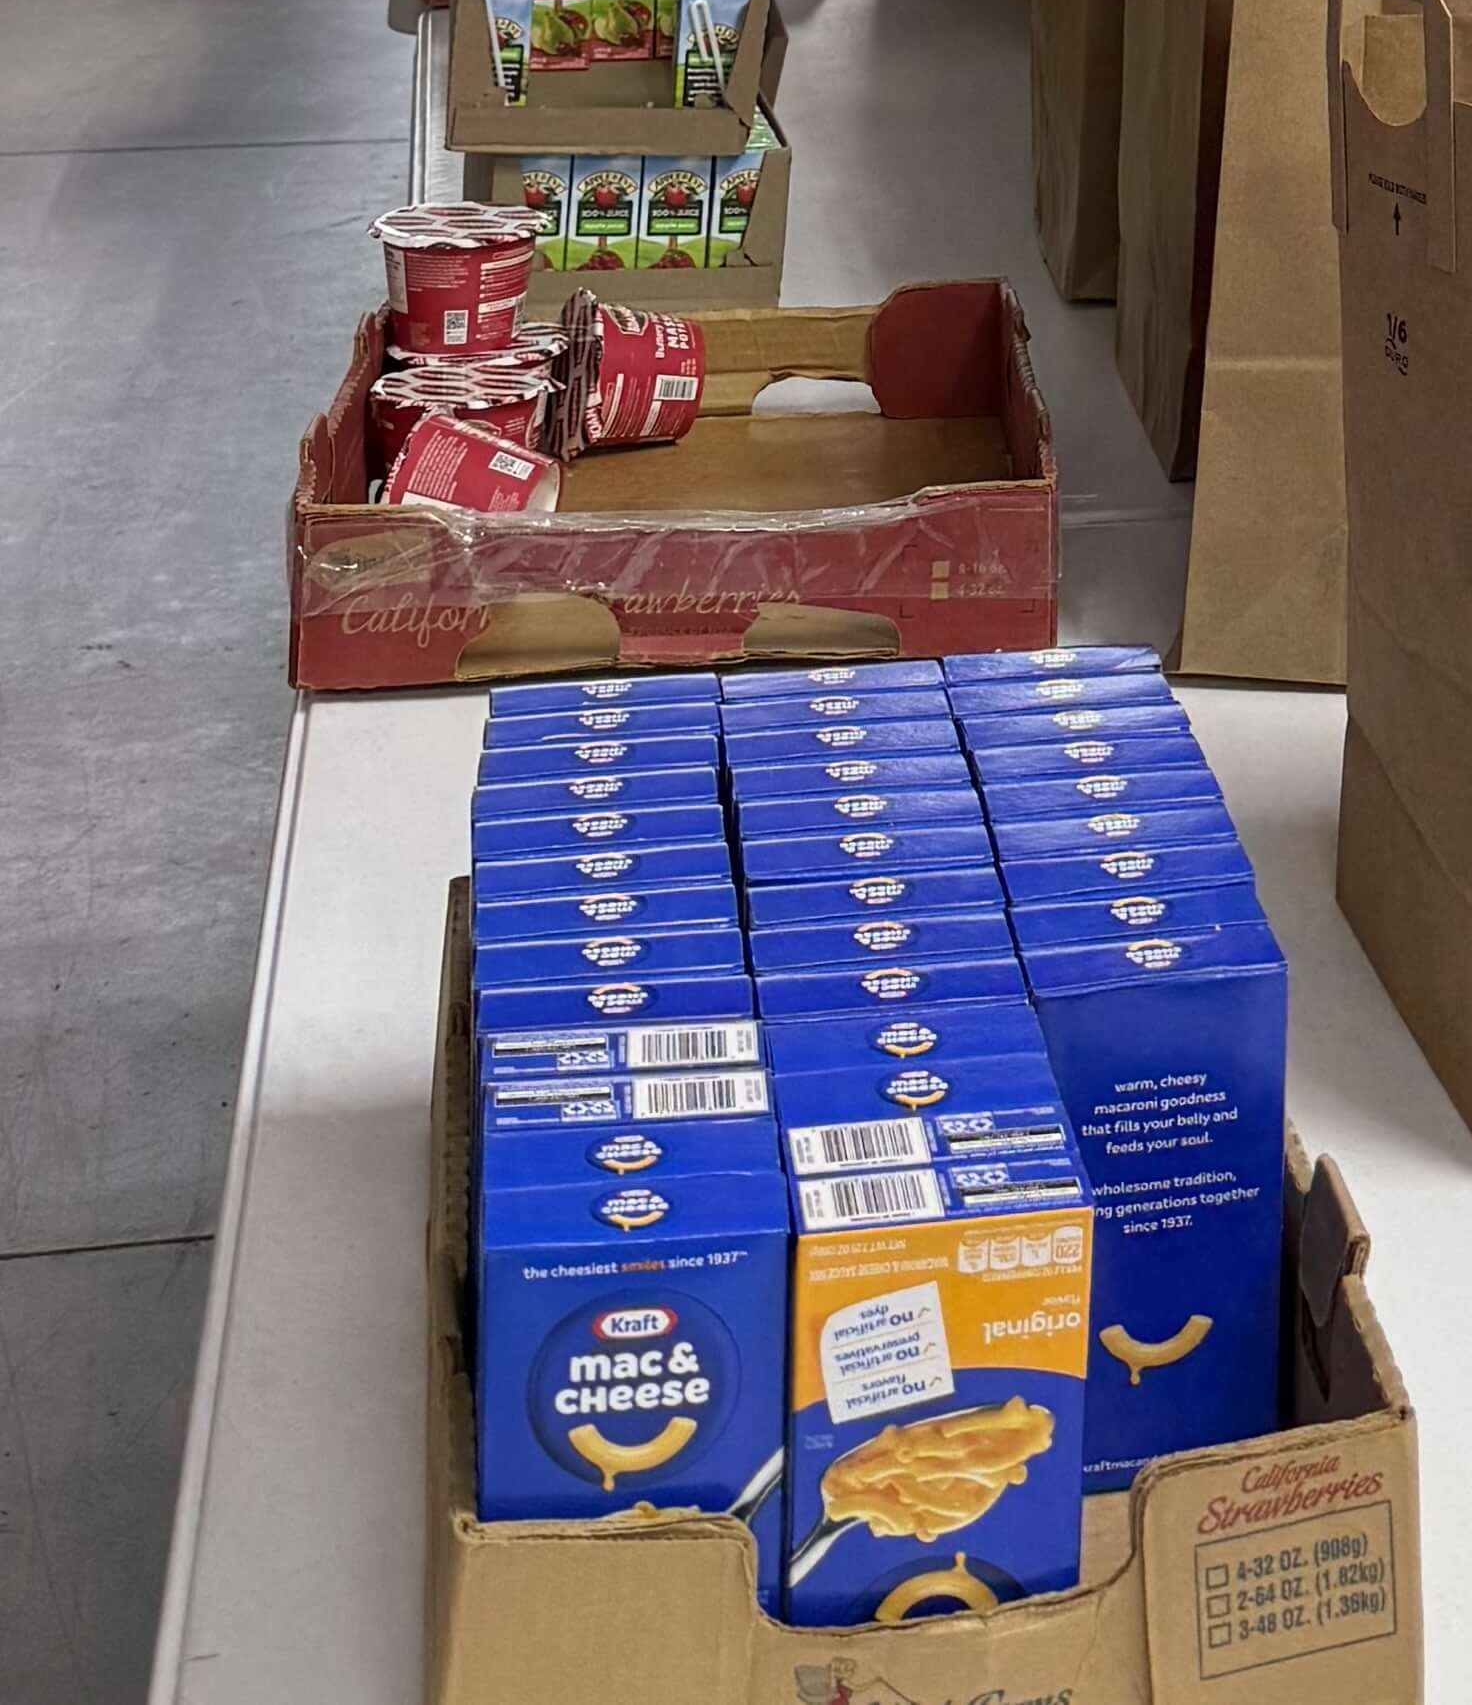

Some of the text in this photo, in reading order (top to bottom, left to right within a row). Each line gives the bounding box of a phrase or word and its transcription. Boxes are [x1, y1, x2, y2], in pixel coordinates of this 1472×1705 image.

[341, 591, 489, 649] Califor
[1114, 1072, 1207, 1093] warm, cheesy
[1093, 1091, 1226, 1116] macaroni goodness
[1081, 1107, 1238, 1137] that fills your belly and
[1105, 1131, 1214, 1155] feeds your soul.
[1173, 1170, 1237, 1189] tradition,
[1115, 1196, 1198, 1219] generations
[1200, 1186, 1260, 1206] together
[1123, 1215, 1193, 1234] since 1937.
[1055, 1243, 1080, 1259] 220
[523, 1266, 547, 1280] the
[551, 1261, 618, 1278] cheesiest
[668, 1254, 704, 1270] since
[859, 1303, 889, 1319] dyes
[1041, 1293, 1081, 1306] flavor
[610, 1314, 659, 1334] Kraft
[833, 1310, 914, 1341] no artificial
[982, 1310, 1081, 1344] original
[833, 1331, 920, 1361] preservatives
[838, 1345, 920, 1376] no artificial
[569, 1341, 700, 1383] mac &
[845, 1379, 926, 1410] no artificial
[861, 1373, 907, 1391] flavors
[1241, 1454, 1340, 1494] California
[1196, 1471, 1385, 1535] Strawberries
[1236, 1532, 1369, 1582] 4-32 OZ. (908g)
[1236, 1585, 1276, 1612] 2-64
[1281, 1577, 1310, 1599] OZ.
[1238, 1613, 1277, 1641] 3-48
[1282, 1606, 1312, 1629] OZ.
